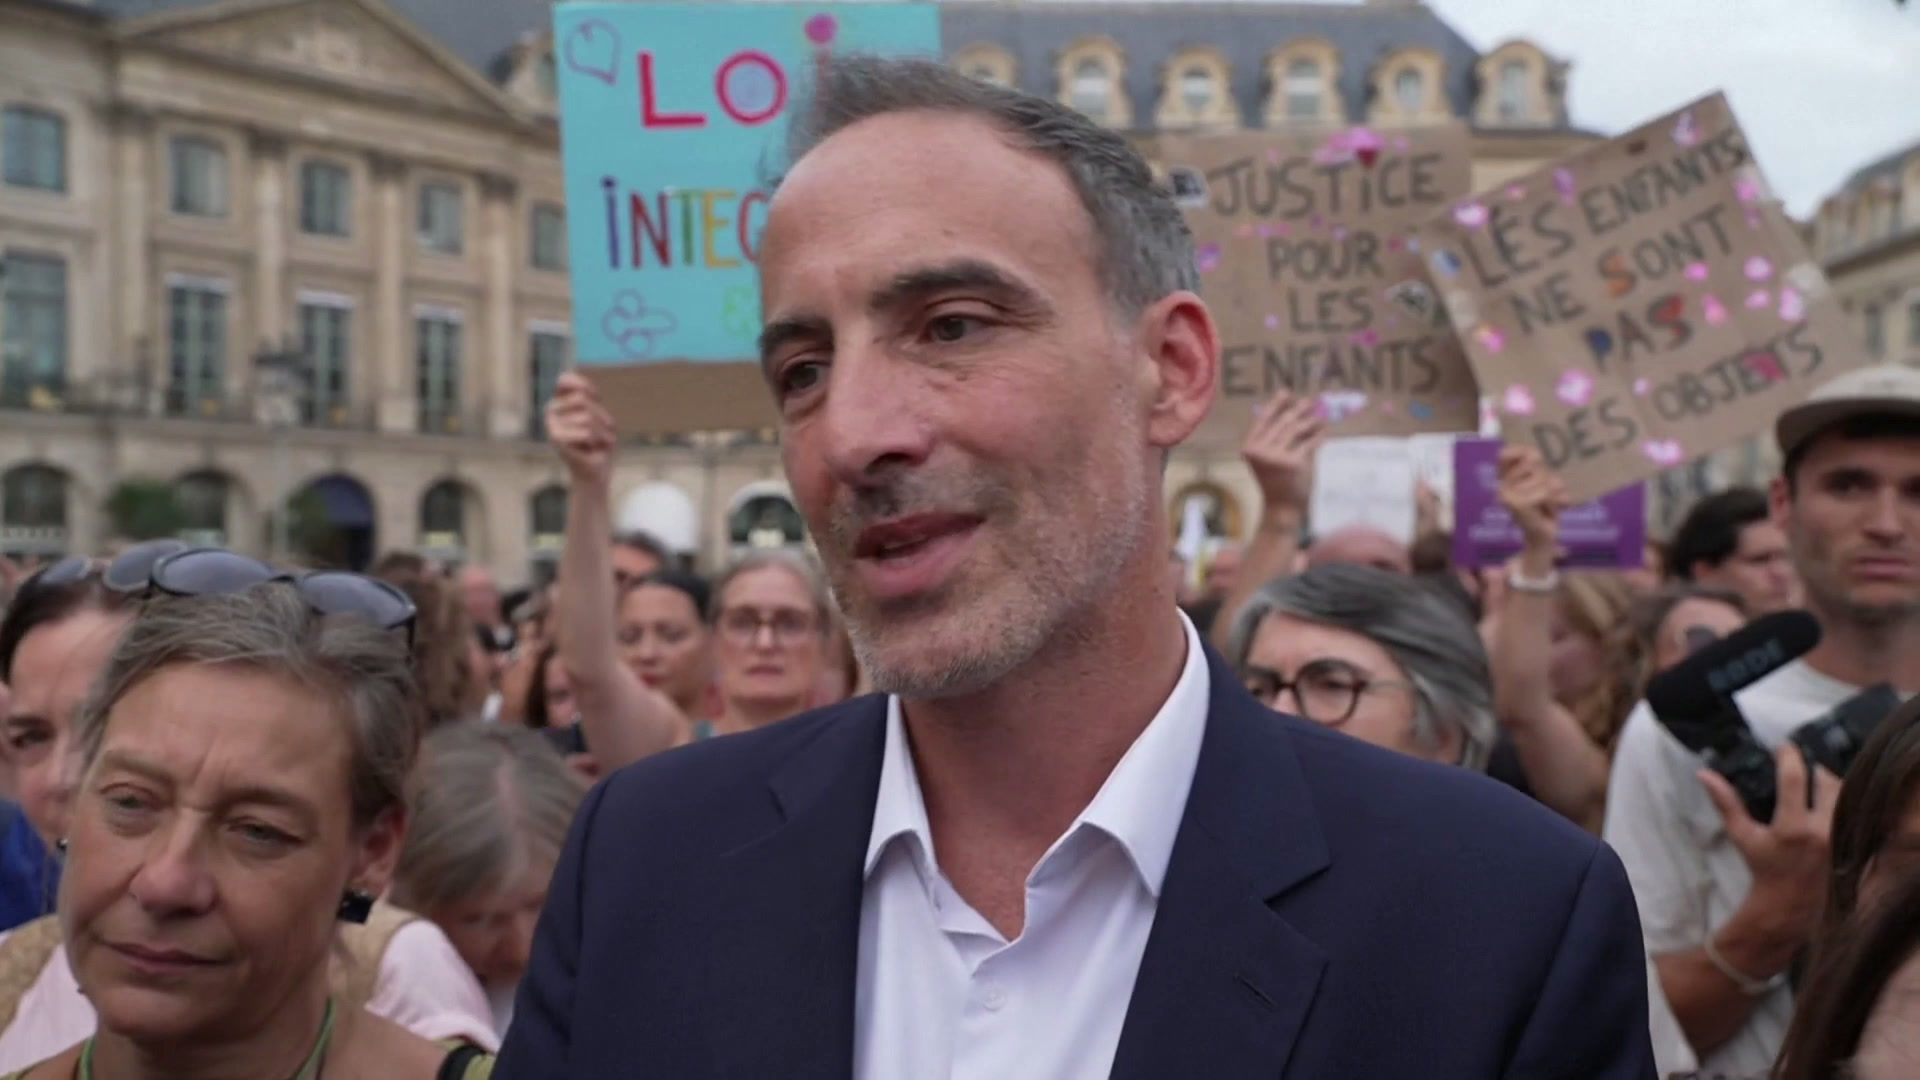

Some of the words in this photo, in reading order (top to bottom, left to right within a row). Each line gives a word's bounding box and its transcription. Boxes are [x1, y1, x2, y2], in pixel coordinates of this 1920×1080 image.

[1461, 202, 1575, 287] LES
[1580, 129, 1748, 237] ENFANTS
[1267, 230, 1383, 281] POUR
[1509, 273, 1586, 334] NE
[1599, 204, 1735, 298] SONT
[1287, 286, 1375, 333] LES
[1586, 293, 1693, 373] PAS
[1221, 336, 1442, 396] ENFANTS
[1532, 398, 1638, 470] DES
[1652, 321, 1824, 422] OBJETS
